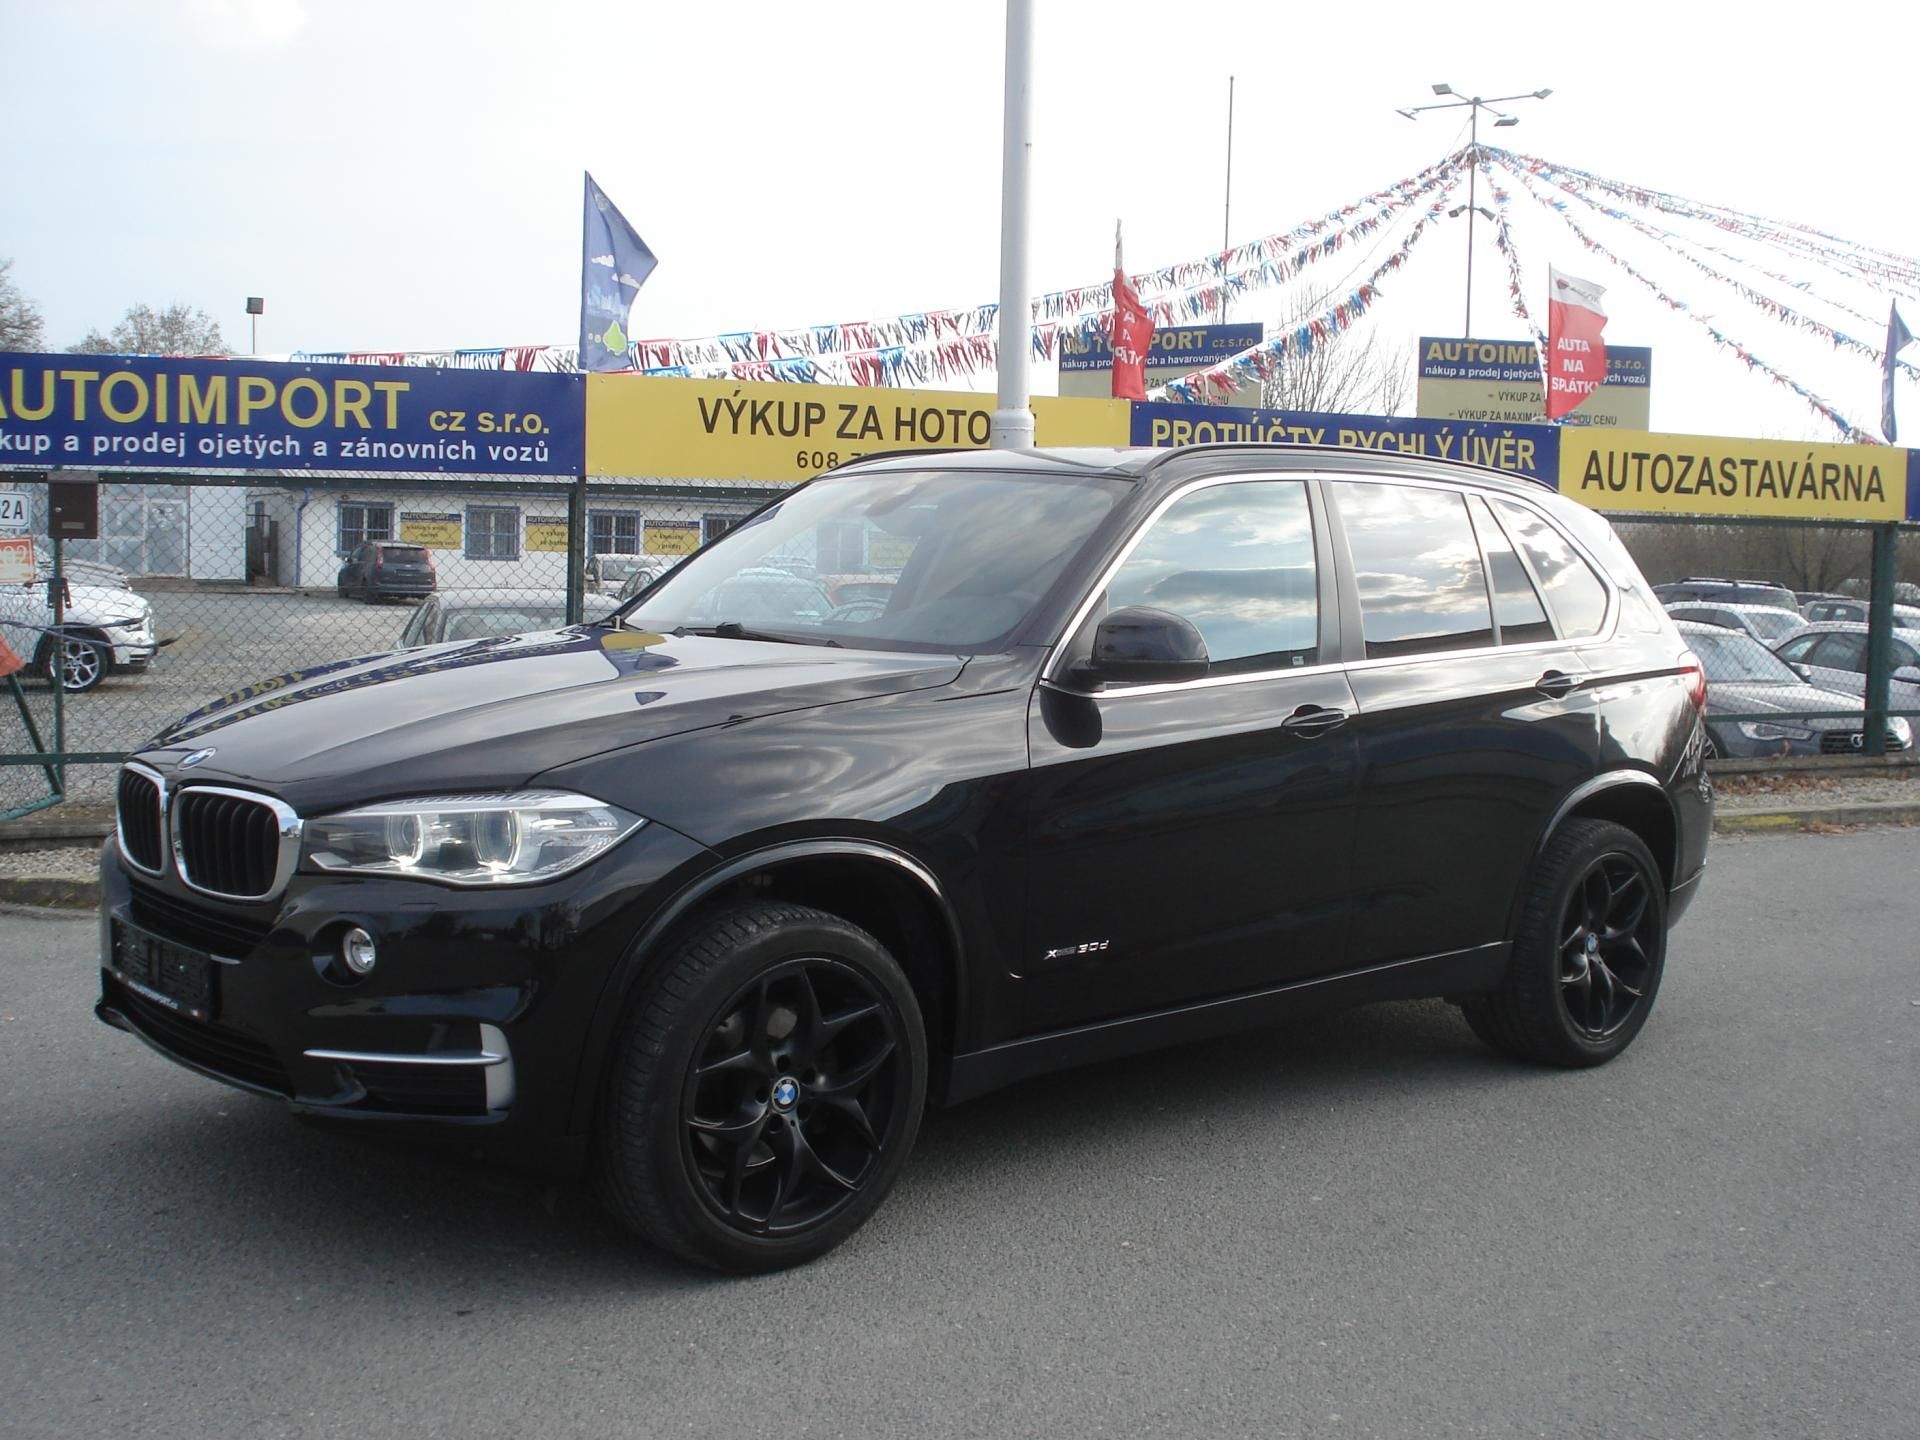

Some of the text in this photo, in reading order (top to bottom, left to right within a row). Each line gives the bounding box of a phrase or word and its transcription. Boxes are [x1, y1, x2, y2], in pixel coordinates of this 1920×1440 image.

[1557, 337, 1590, 352] AUTA
[1062, 358, 1087, 370] nákup
[1160, 357, 1166, 365] a
[1426, 342, 1541, 365] AUTOIMP
[1615, 359, 1645, 369] s.r.o.
[1425, 366, 1456, 377] nákup
[1468, 368, 1500, 380] prodej
[1503, 370, 1540, 381] ojetých
[1563, 359, 1584, 373] NA
[0, 368, 550, 434] UTOIMPORT cz s.r.o.
[1529, 392, 1541, 402] ZA
[698, 390, 1037, 446] VÝKUP ZA HOTO
[1458, 409, 1487, 420] VÝKUP
[1490, 411, 1501, 420] ZA
[1594, 414, 1617, 425] CENU
[64, 434, 80, 452] a
[93, 432, 186, 458] prodej
[198, 432, 300, 460] ojetých
[313, 440, 328, 457] a
[340, 437, 476, 461] zánovních
[488, 441, 549, 462] vozů
[1462, 428, 1536, 471] ÚVĚR
[797, 451, 839, 469] 608
[1581, 449, 1886, 503] AUTOZASTAVÁRNA
